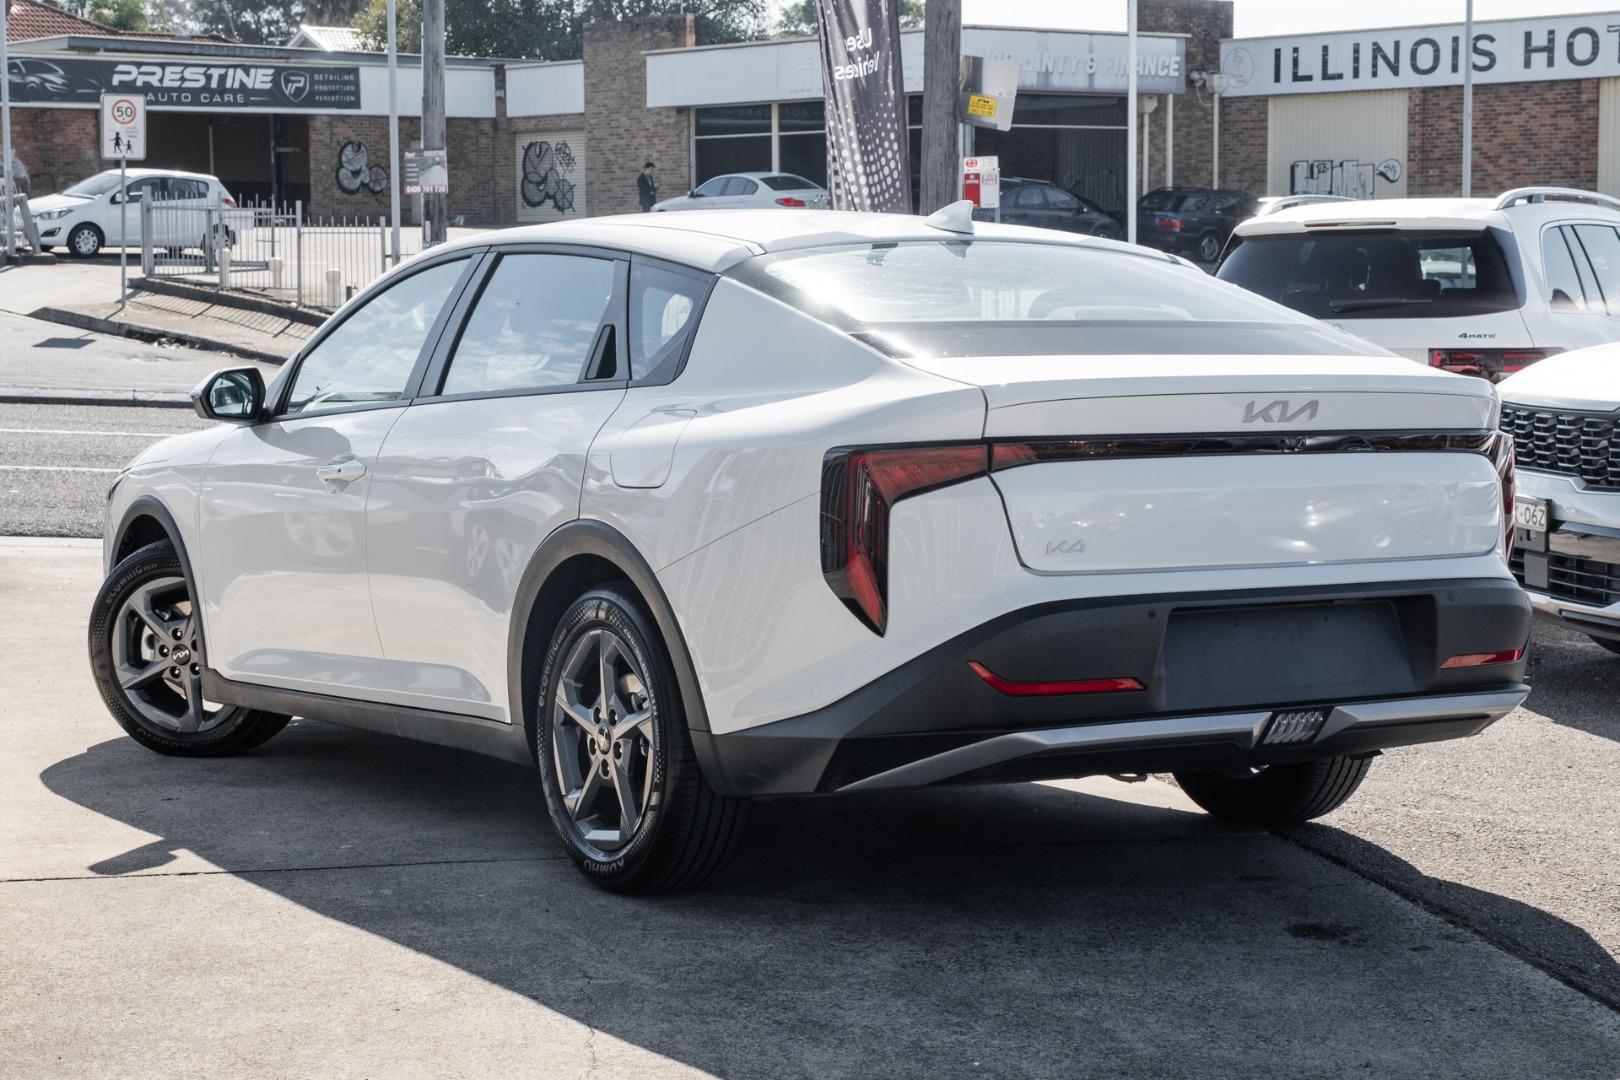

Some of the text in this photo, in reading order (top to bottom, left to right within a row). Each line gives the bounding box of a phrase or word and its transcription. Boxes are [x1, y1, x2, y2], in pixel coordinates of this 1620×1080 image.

[1086, 53, 1097, 74] &
[1103, 55, 1181, 77] FINANCE
[1274, 33, 1497, 84] ILLINOIS
[112, 64, 275, 90] PRESTINE
[146, 92, 245, 103] AUTO CARE
[116, 106, 133, 118] 50
[1241, 400, 1319, 424] KIA
[1046, 539, 1086, 555] K4
